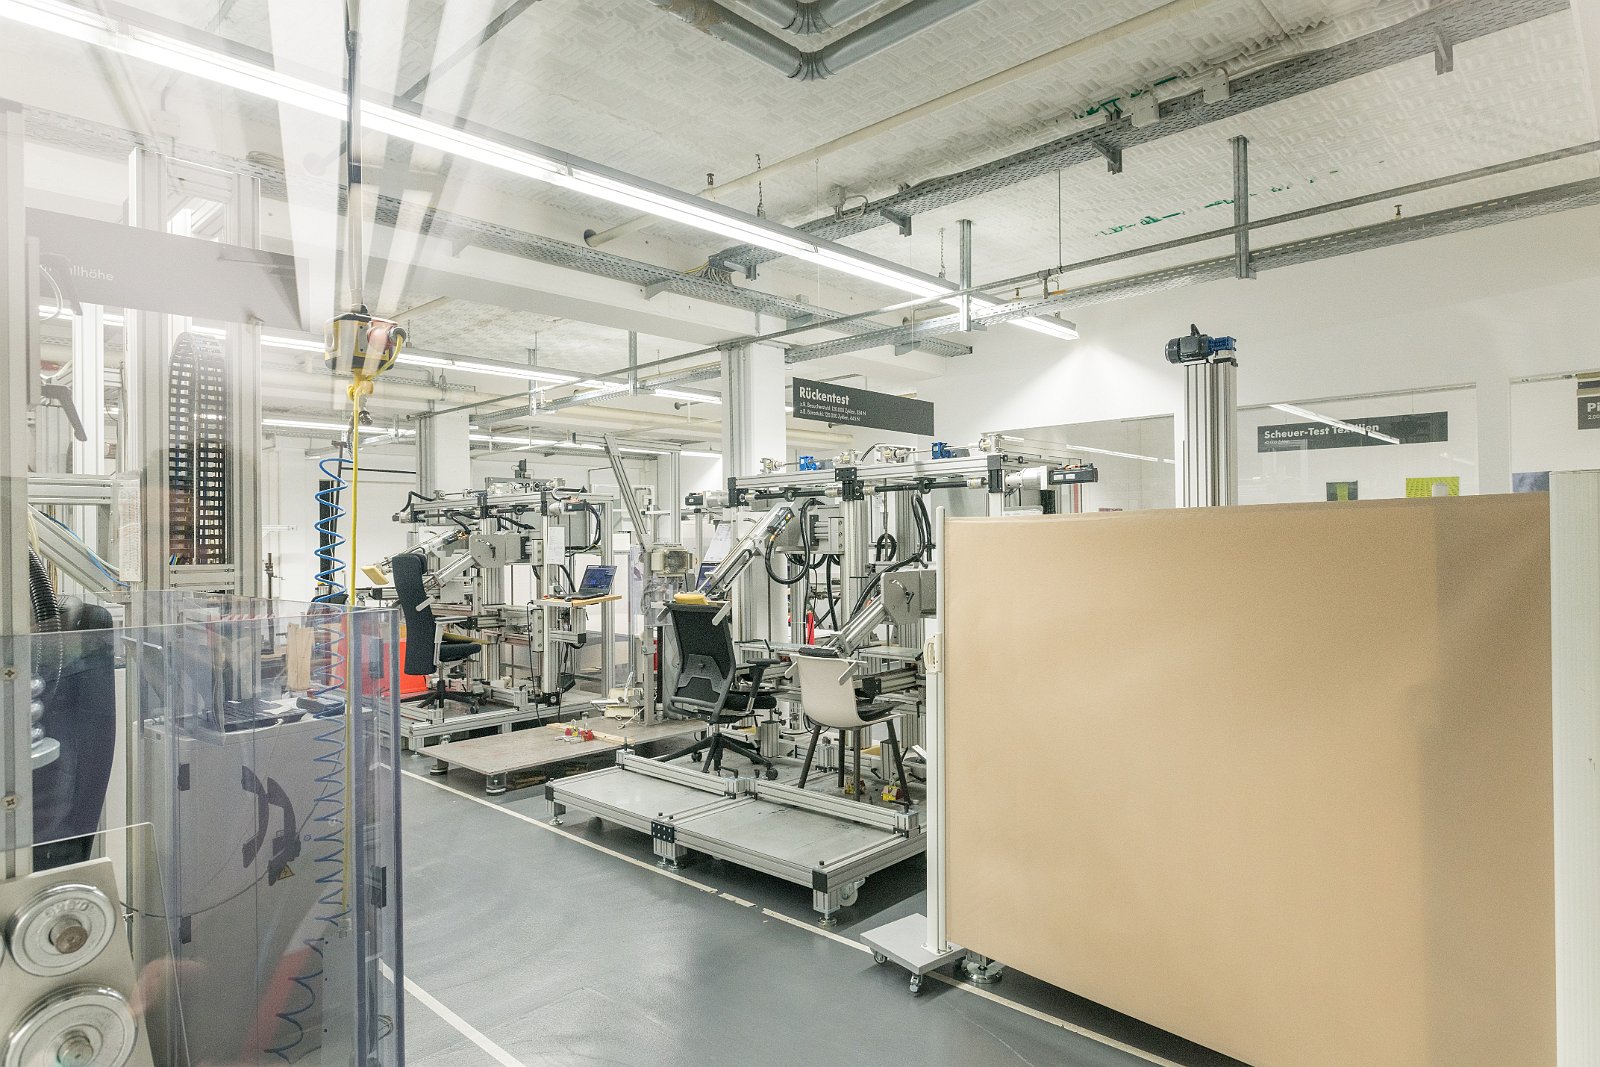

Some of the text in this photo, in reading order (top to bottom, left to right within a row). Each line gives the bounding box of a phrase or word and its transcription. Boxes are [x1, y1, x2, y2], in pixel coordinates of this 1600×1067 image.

[799, 386, 850, 405] Rückentest
[1263, 423, 1380, 439] Scheuer-Test Texlien
